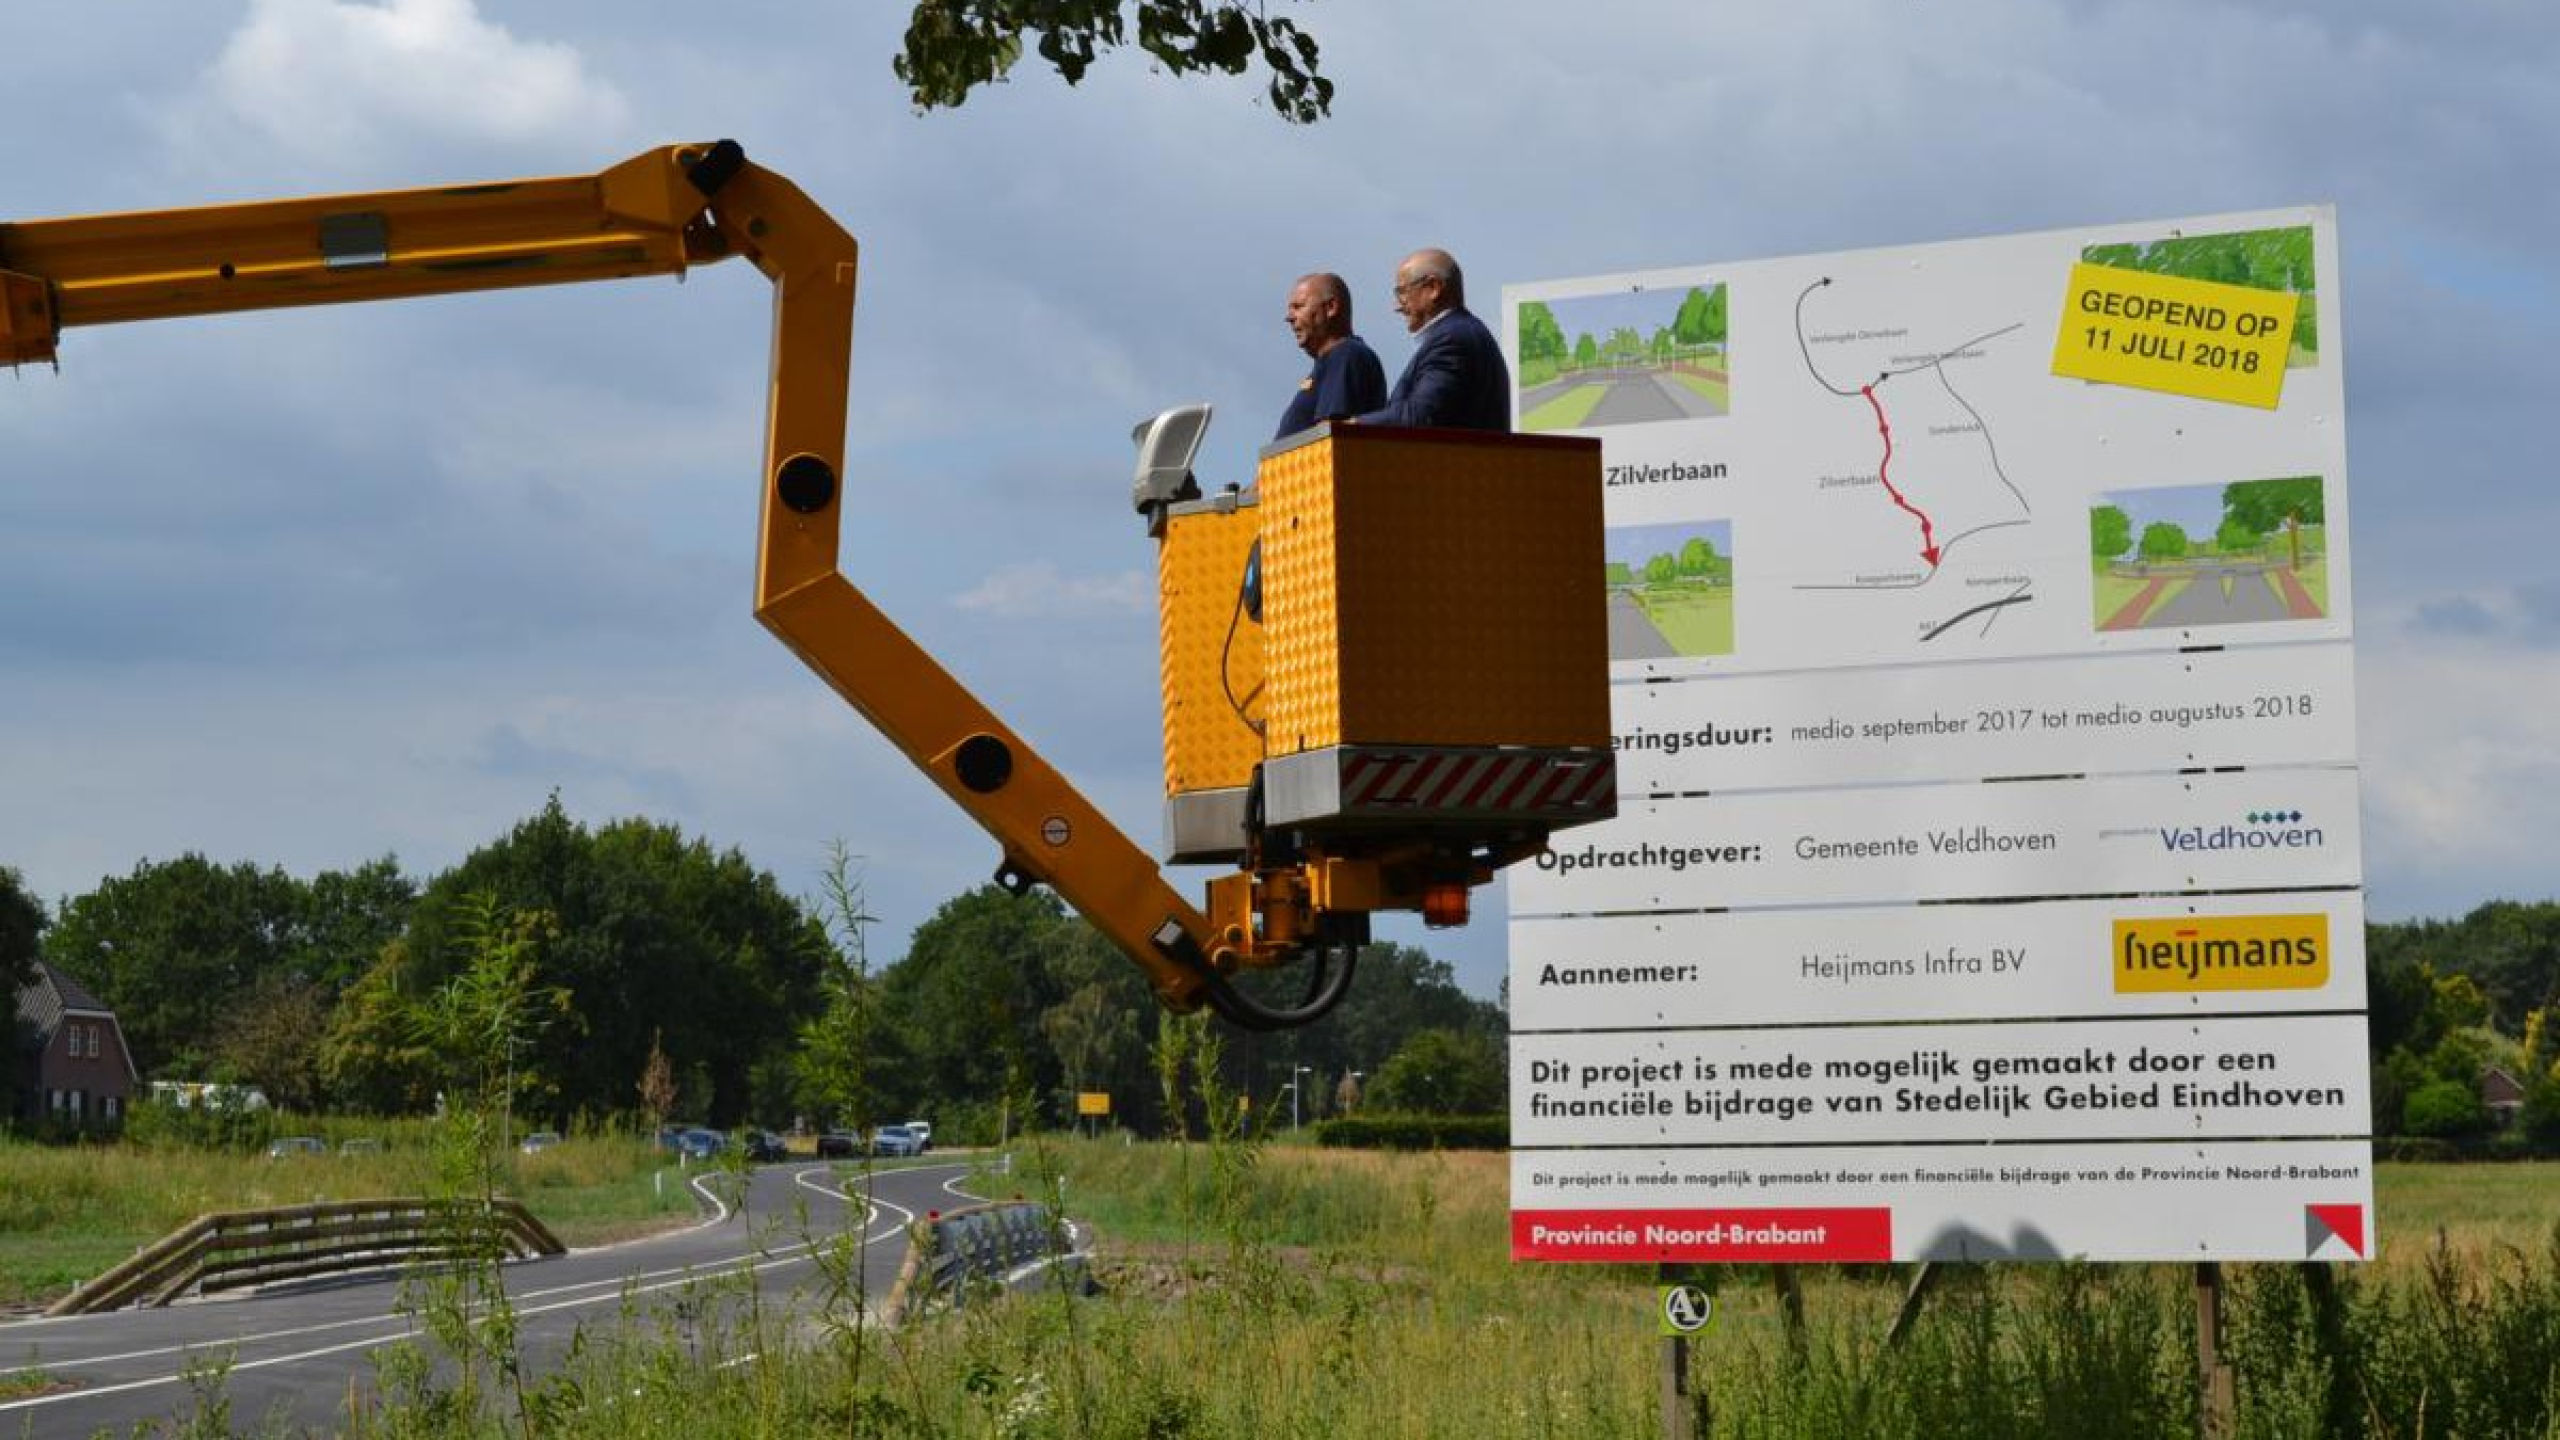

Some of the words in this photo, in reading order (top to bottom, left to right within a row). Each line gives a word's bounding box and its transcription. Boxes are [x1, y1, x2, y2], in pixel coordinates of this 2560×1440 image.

[2080, 289, 2227, 332] GEOPEND
[2235, 312, 2278, 338] OP
[2085, 328, 2111, 352] 11
[2121, 333, 2186, 362] JULI
[2193, 342, 2260, 374] 2018
[1606, 461, 1727, 487] Zilverbaan
[1611, 722, 1773, 754] eringsduur:
[1791, 714, 1854, 741] medio
[1862, 711, 1968, 738] september
[1977, 708, 2034, 733] 2017
[2041, 708, 2068, 729] tot
[2075, 702, 2143, 727] medio
[2149, 702, 2245, 728] augustus
[2254, 695, 2313, 719] 2018
[1536, 841, 1762, 877] Opdrachtgever:
[1795, 834, 1919, 861] Gemeente
[1927, 826, 2056, 855] Veldhoven
[2161, 826, 2323, 852] Veldhoven
[1540, 962, 1698, 986] Aannemer:
[1801, 952, 1915, 984] Heijmans
[1925, 946, 1982, 974] Infra
[1992, 948, 2026, 973] BV
[2125, 930, 2317, 980] heijmans
[1531, 1059, 1571, 1084] Dit
[1582, 1057, 1684, 1090] project
[1695, 1056, 1718, 1081] is
[1729, 1054, 1813, 1081] mede
[1825, 1051, 1960, 1084] mogelijk
[1972, 1047, 2117, 1083] gemaakt
[2128, 1047, 2205, 1074] door
[2217, 1053, 2276, 1072] een
[1530, 1090, 1674, 1118] financiële
[1684, 1089, 1814, 1122] bijdrage
[1825, 1094, 1883, 1113] van
[1895, 1086, 2032, 1118] Stedelijk
[2043, 1082, 2160, 1111] Gebied
[2173, 1081, 2345, 1108] Eindhoven
[1533, 1172, 1554, 1185] Dit
[1558, 1172, 1612, 1189] project
[1616, 1172, 1630, 1185] is
[1635, 1171, 1678, 1185] mede
[1684, 1170, 1752, 1189] mogelijk
[1757, 1169, 1831, 1187] gemaakt
[1836, 1169, 1874, 1184] door
[1879, 1171, 1910, 1183] een
[1914, 1168, 1995, 1184] financiële
[2000, 1167, 2072, 1186] bijdrage
[2077, 1169, 2109, 1181] van
[2113, 1167, 2136, 1181] de
[2141, 1166, 2220, 1181] Provincie
[2226, 1164, 2360, 1181] Noord-Brabant
[1532, 1224, 1637, 1246] Provincie
[1646, 1224, 1827, 1246] Noord-Brabant
